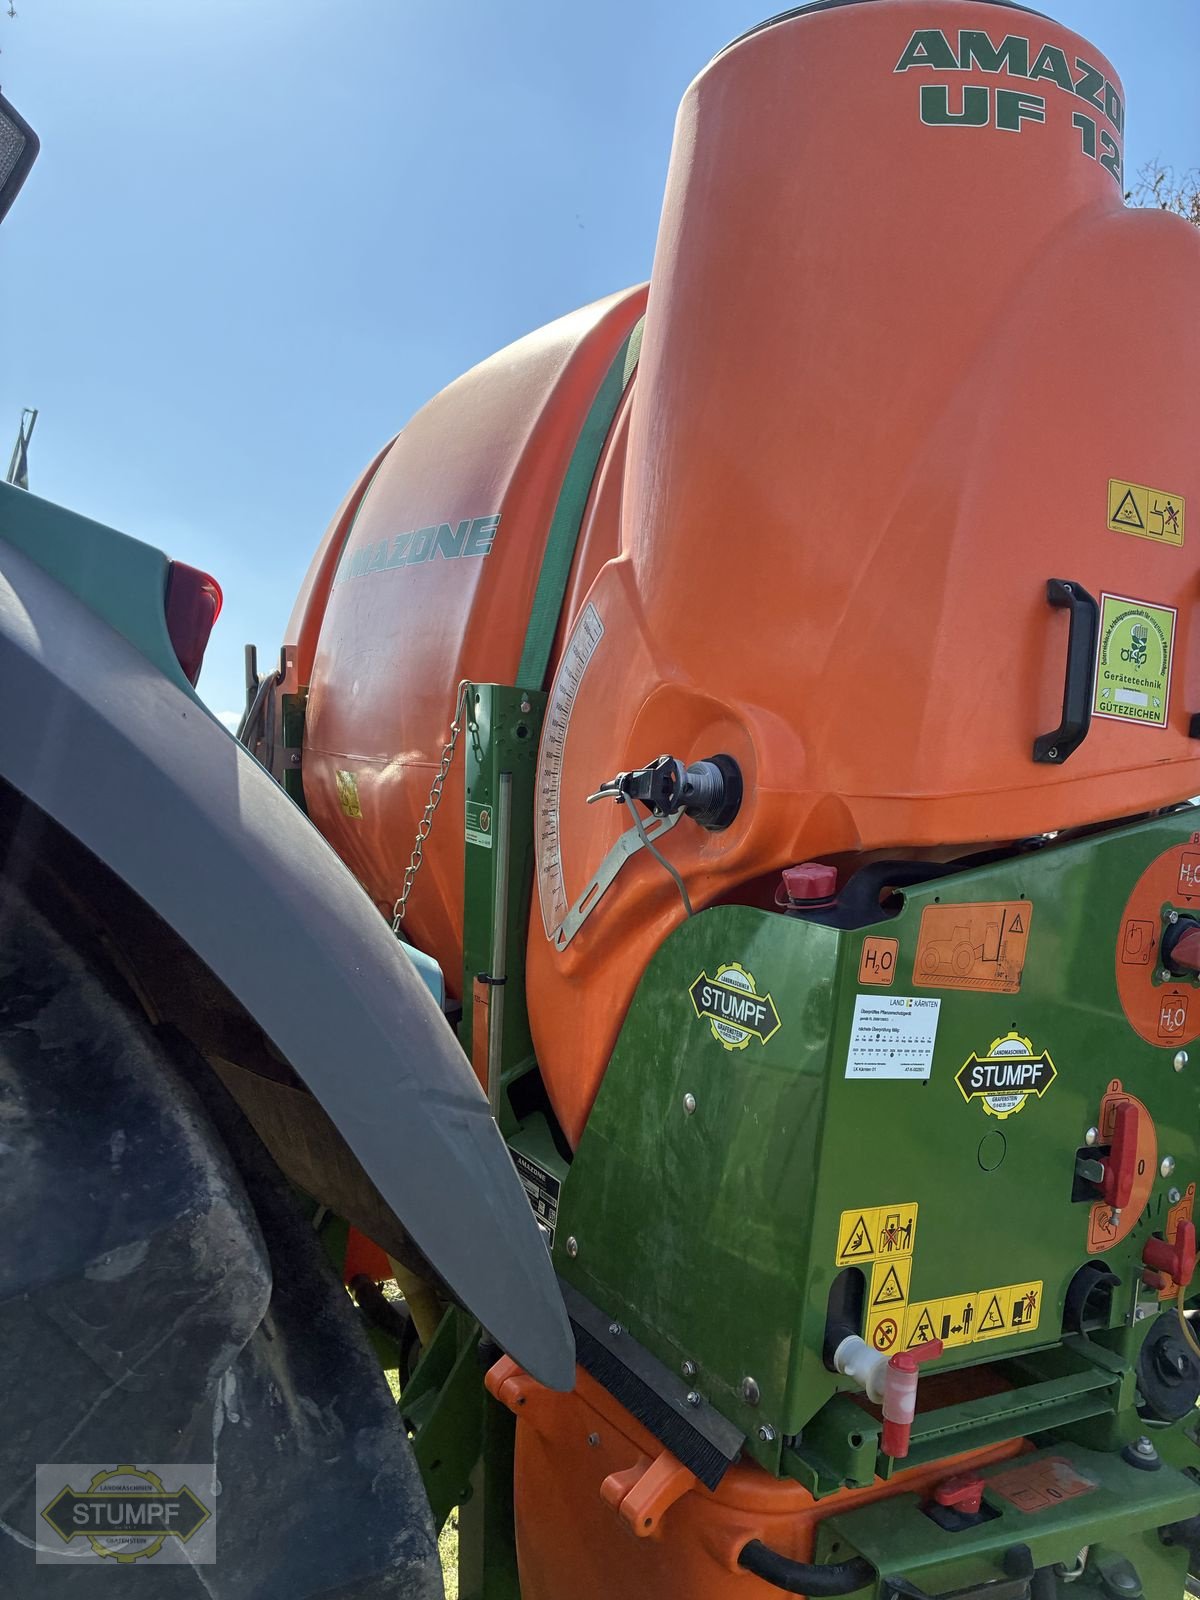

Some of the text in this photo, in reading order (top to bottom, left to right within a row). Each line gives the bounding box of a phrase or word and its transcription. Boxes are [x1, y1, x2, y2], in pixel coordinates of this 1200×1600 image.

[893, 29, 1123, 140] AMAZO
[920, 84, 1123, 185] UF 12
[1103, 670, 1162, 690] Gerätetechnik
[1099, 701, 1161, 721] GÜTEZEICHEN
[1193, 832, 1199, 844] B
[865, 949, 893, 975] H2O
[701, 986, 767, 1026] STUMPF
[889, 999, 939, 1008] LAND KÄRNTEN
[1160, 1008, 1186, 1032] H2O
[970, 1063, 1044, 1088] STUMPF
[1111, 1081, 1119, 1092] D
[518, 1157, 547, 1182] AMAZONE
[1187, 1185, 1194, 1196] C
